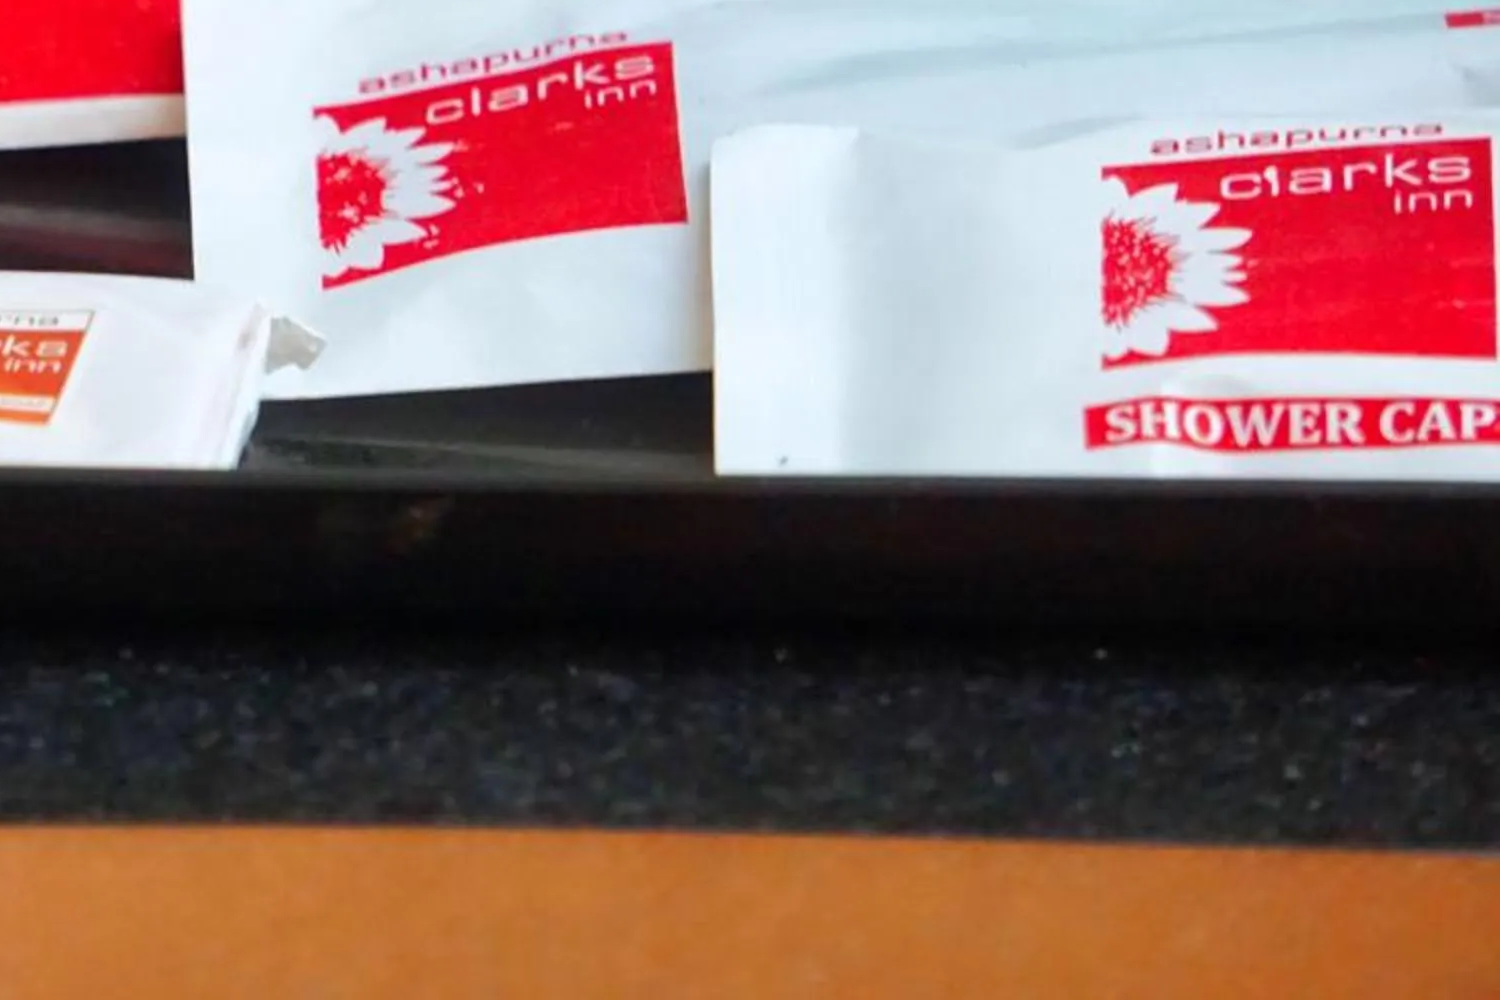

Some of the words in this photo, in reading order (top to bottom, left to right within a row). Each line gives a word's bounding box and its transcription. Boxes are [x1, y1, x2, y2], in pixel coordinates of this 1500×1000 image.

[359, 30, 628, 94] ashapurna
[426, 55, 656, 126] clarks
[584, 79, 658, 110] inn
[1151, 123, 1443, 155] ashapurna
[1220, 152, 1472, 201] clarks
[1394, 188, 1474, 215] inn
[4, 356, 63, 375] inn
[1104, 399, 1366, 448] SHOWER
[1379, 401, 1497, 444] CAP
